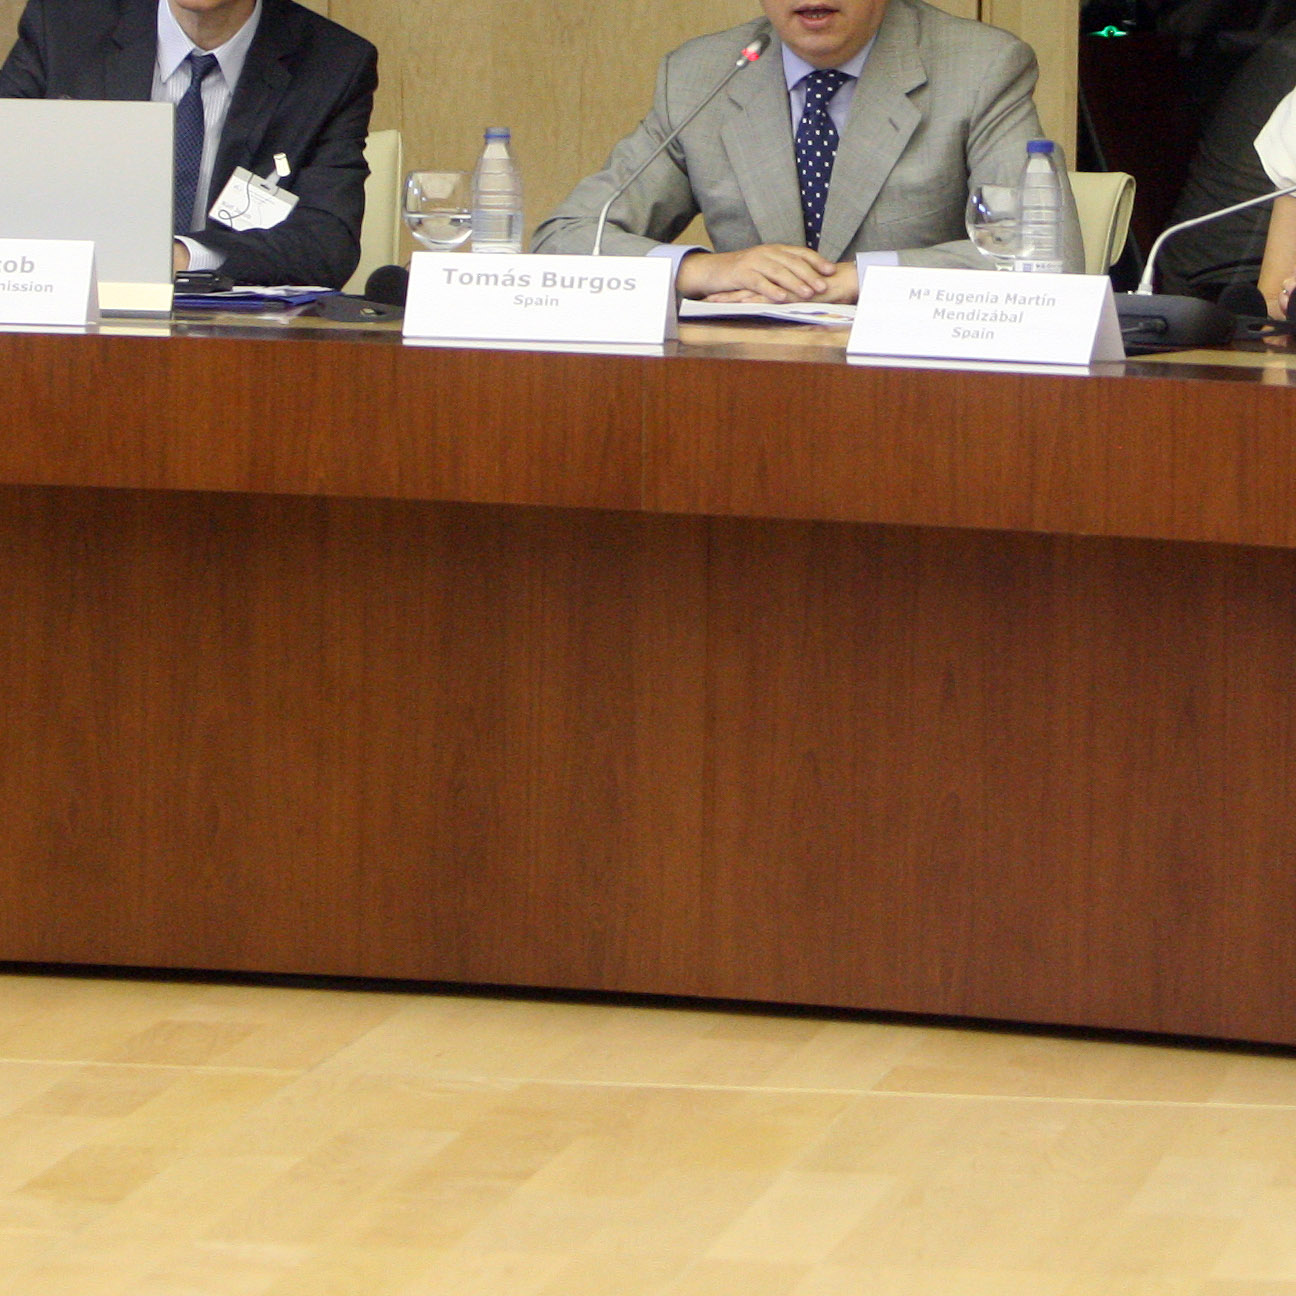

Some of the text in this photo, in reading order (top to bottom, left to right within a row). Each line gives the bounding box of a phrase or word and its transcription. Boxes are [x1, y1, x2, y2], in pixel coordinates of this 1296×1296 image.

[443, 268, 636, 294] Tomás Burgos
[513, 295, 559, 308] Spain
[936, 290, 999, 305] Eugenia
[1005, 293, 1055, 306] Martín
[933, 308, 1023, 323] Mendizábal
[952, 327, 994, 339] Spain
